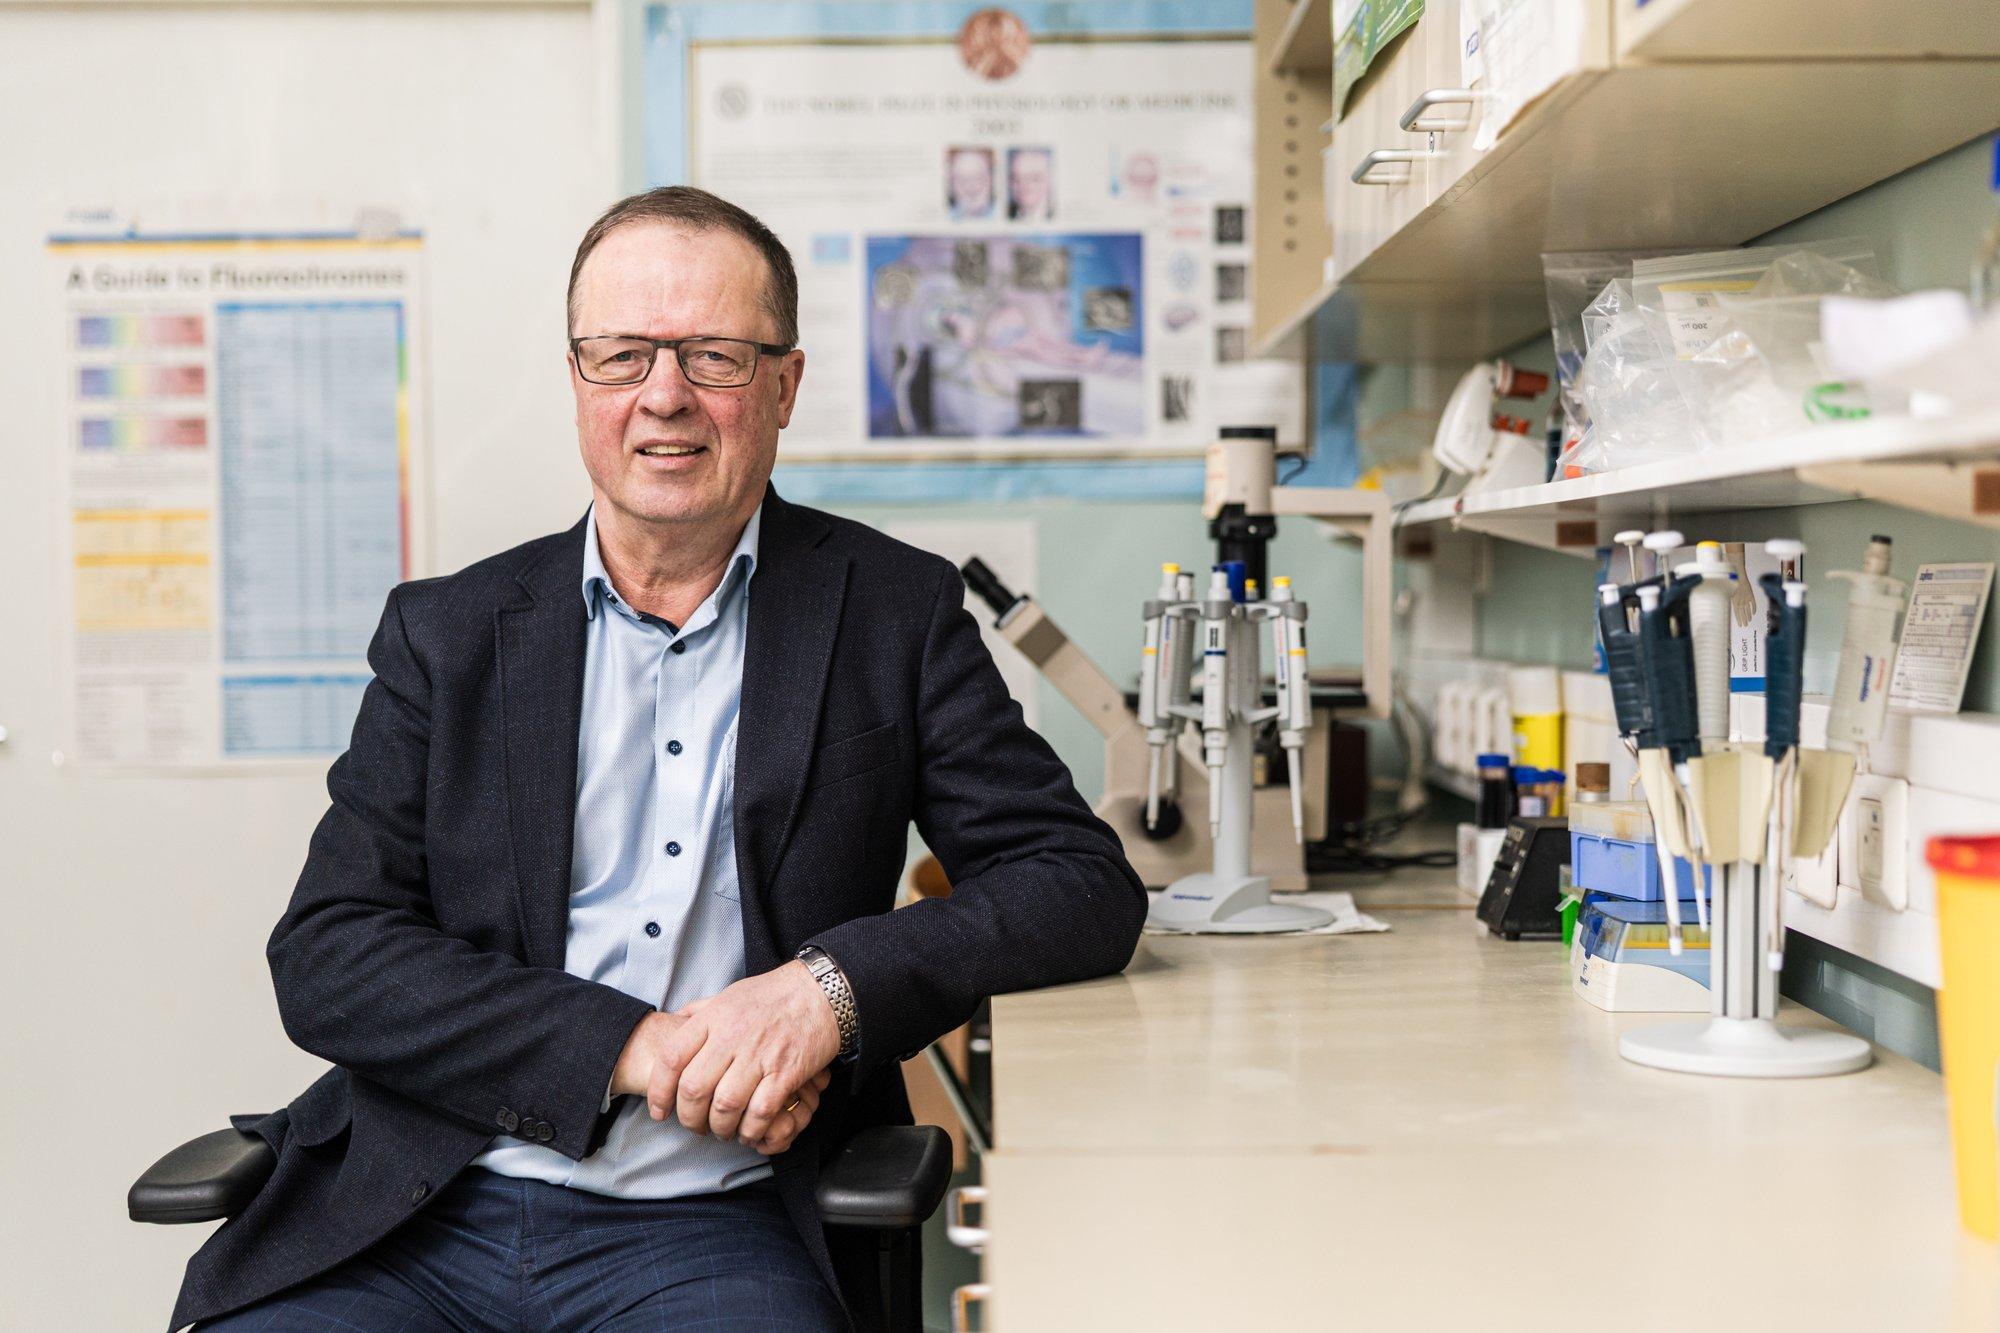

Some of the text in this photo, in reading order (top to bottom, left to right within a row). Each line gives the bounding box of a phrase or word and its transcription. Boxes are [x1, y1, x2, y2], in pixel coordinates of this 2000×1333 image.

[66, 262, 408, 291] A Guide to Fluorochromes
